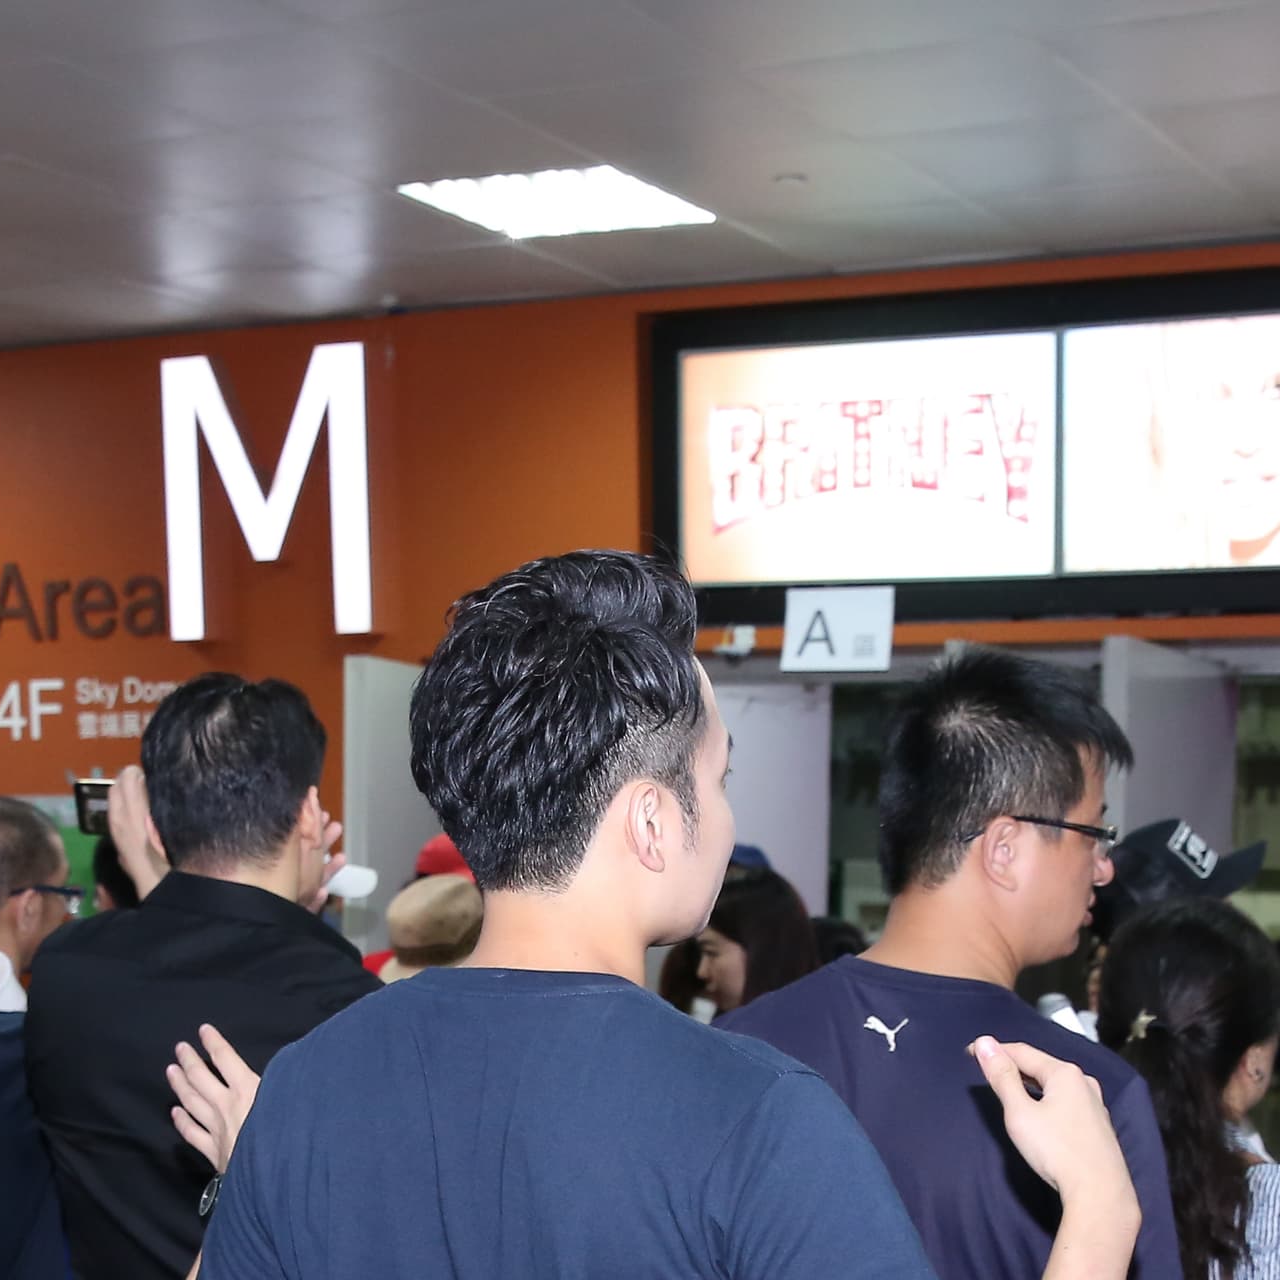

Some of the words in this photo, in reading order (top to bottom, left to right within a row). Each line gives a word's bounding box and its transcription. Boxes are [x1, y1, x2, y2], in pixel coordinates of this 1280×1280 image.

[160, 341, 373, 642] M
[797, 608, 836, 658] A
[76, 677, 119, 710] Sky
[122, 675, 185, 704] Dom
